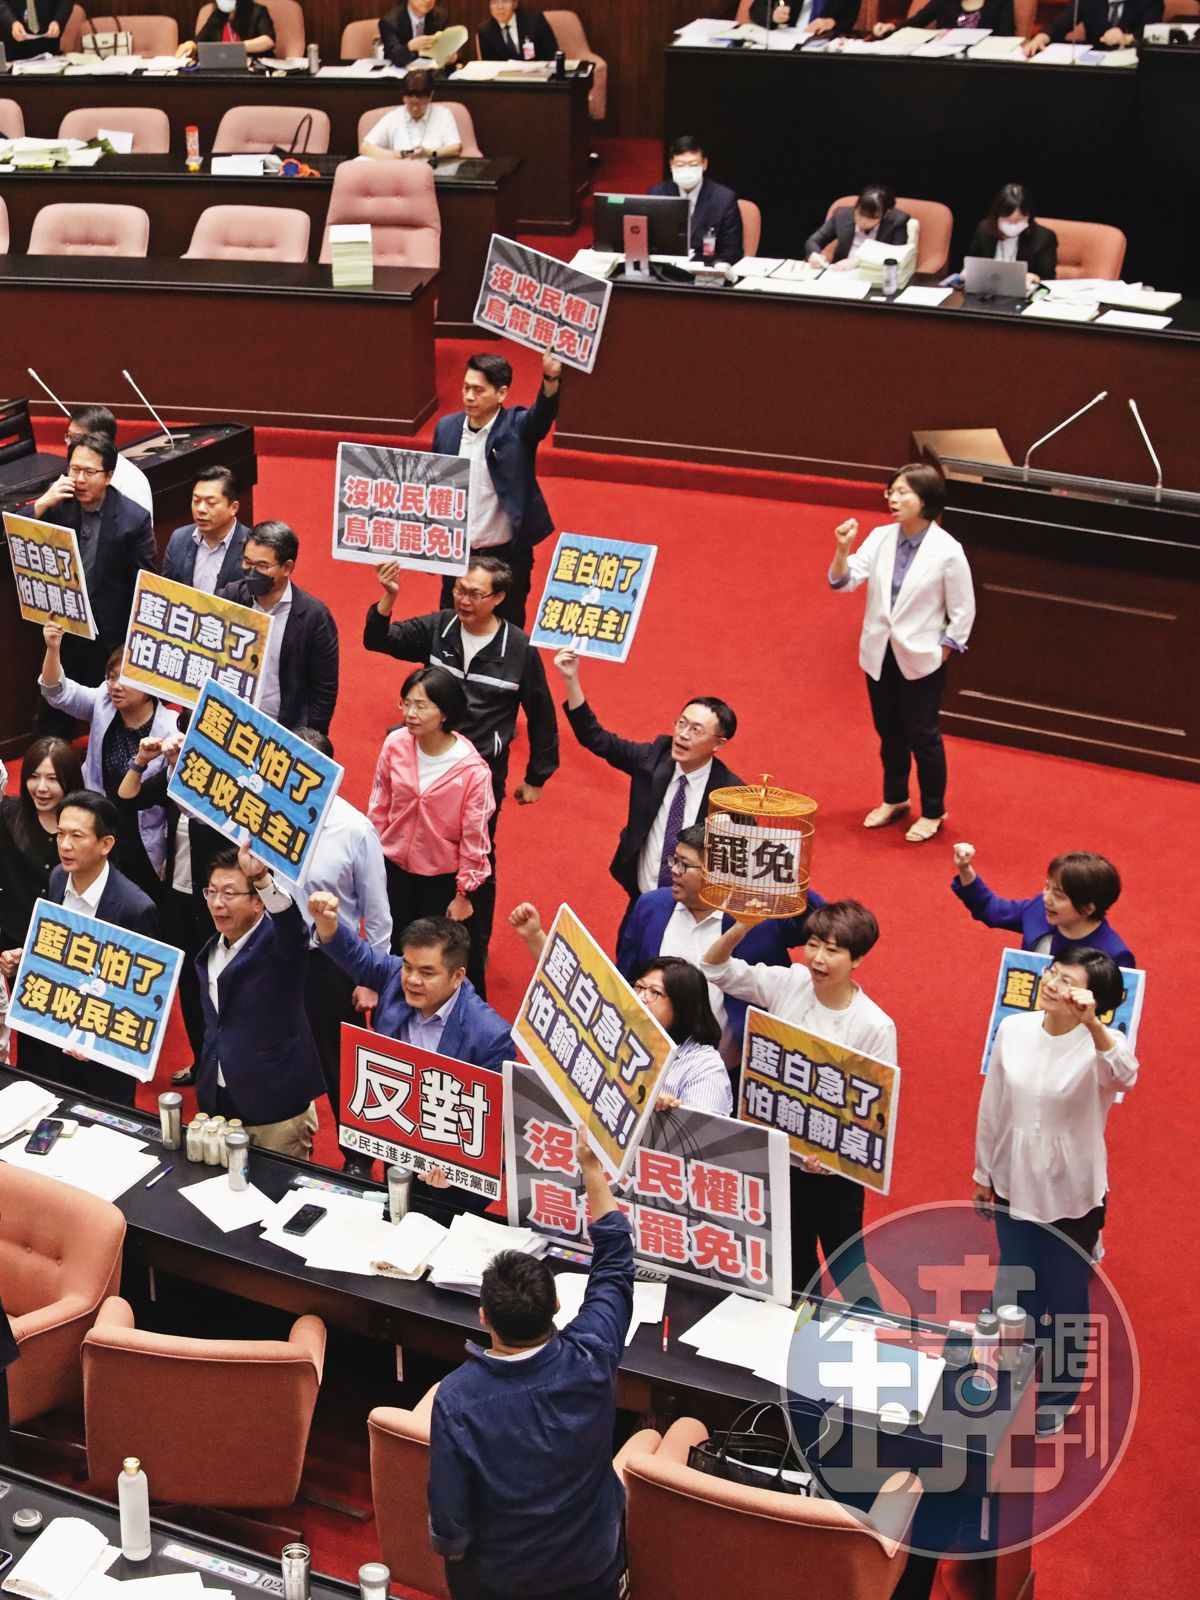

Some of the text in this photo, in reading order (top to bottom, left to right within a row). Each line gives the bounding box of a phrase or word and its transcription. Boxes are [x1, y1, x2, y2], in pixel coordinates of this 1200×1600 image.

[484, 295, 592, 361] 鳥籠罷免!
[489, 264, 599, 330] 沒收民權!
[343, 475, 466, 521] 沒收民權!
[10, 534, 79, 586] 藍白急了,
[342, 514, 463, 559] 鳥籠罷免!
[15, 573, 86, 622] 怕輸翻桌!
[553, 545, 641, 603] 藍白怕了,
[135, 589, 259, 670] 藍白急了,
[540, 598, 630, 644] 沒收民主!
[195, 695, 324, 825] 藍白怕了,
[178, 747, 308, 865] 沒收民主!
[707, 832, 795, 884] 罷免
[32, 918, 166, 1012] 藍白怕了,
[19, 972, 156, 1055] 沒收民主!
[542, 937, 654, 1104] 藍白急了,
[525, 981, 639, 1148] 怕輸翻桌!
[749, 1033, 886, 1129] 藍白急了,
[348, 1045, 490, 1159] 反對
[744, 1080, 884, 1171] 怕輸翻桌!
[524, 1117, 766, 1226] 沒民權!
[639, 1269, 666, 1281] 007
[262, 1578, 285, 1593] 02
